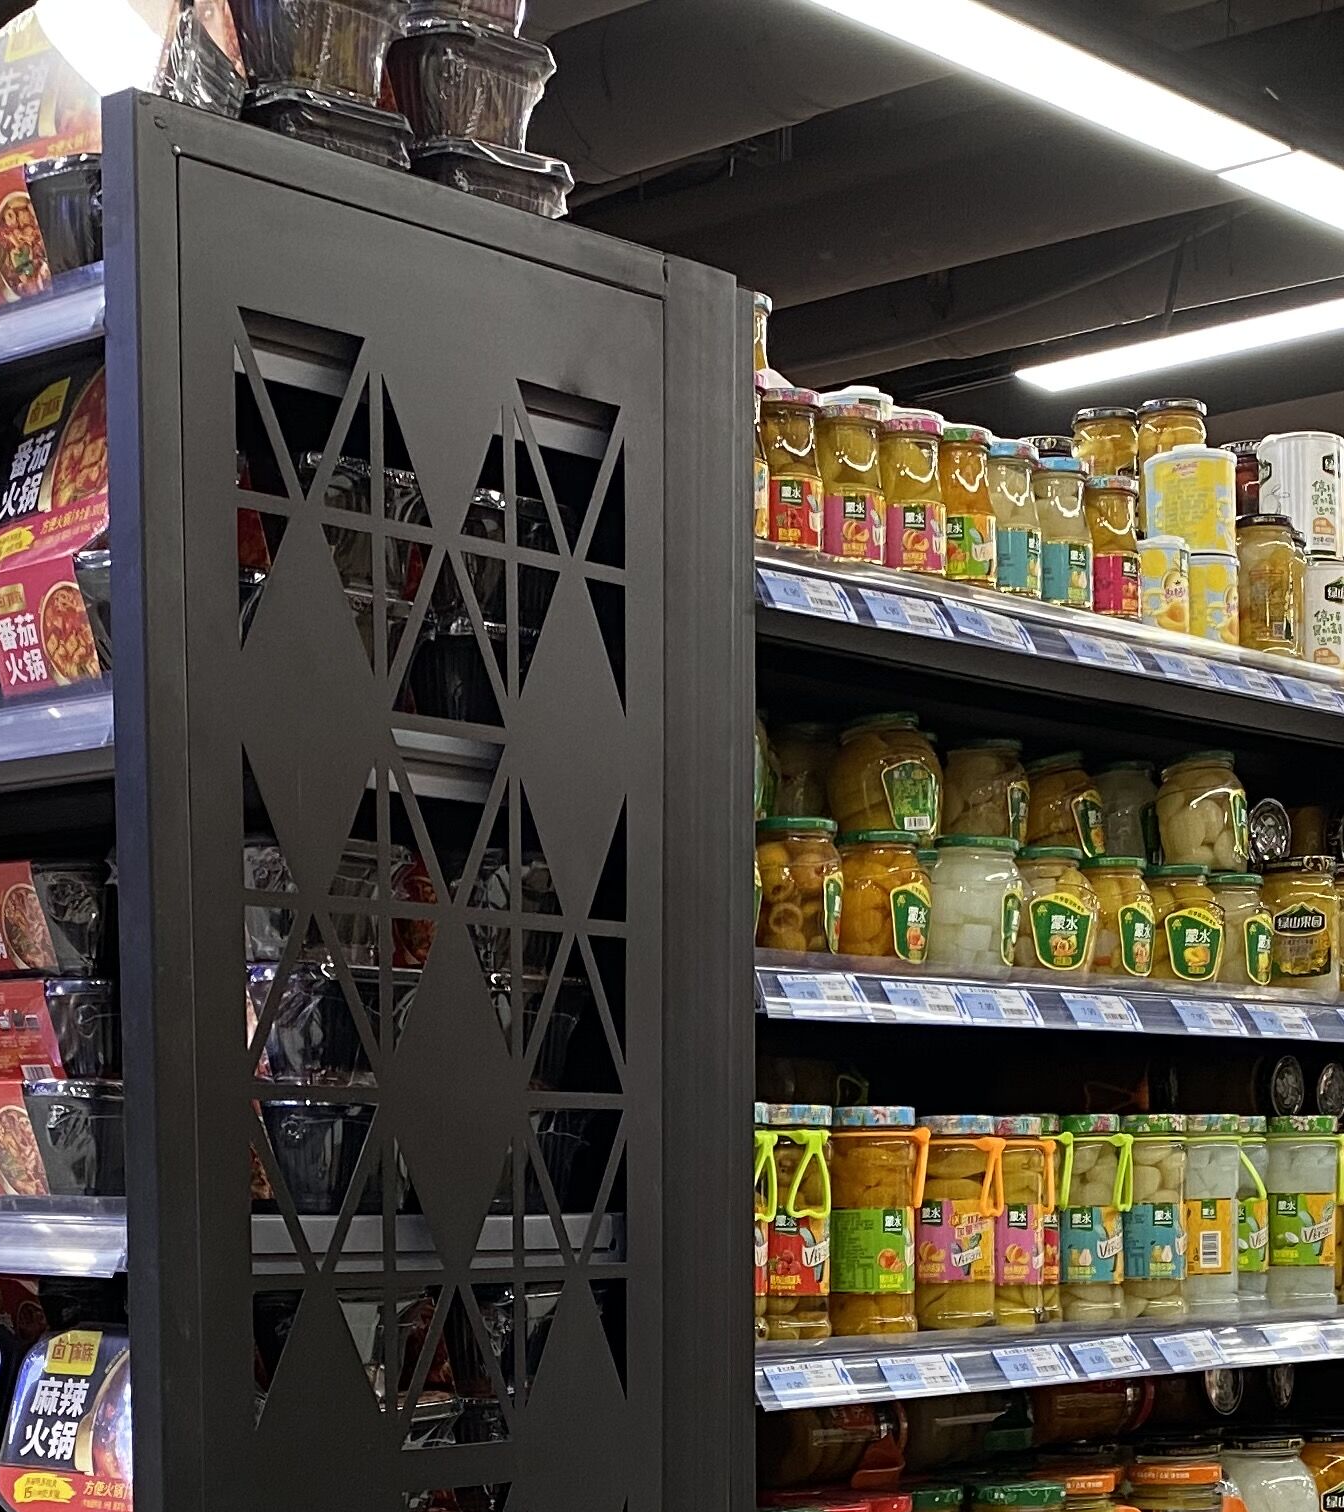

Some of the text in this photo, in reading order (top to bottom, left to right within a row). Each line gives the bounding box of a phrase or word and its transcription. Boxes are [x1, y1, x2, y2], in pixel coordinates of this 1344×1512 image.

[9, 429, 56, 481] 番茄
[5, 649, 48, 685] 火锅
[1051, 915, 1079, 931] 蒙水
[1278, 915, 1323, 929] 绿山果园
[29, 1377, 90, 1418] 麻辣
[19, 1419, 78, 1461] 火锅
